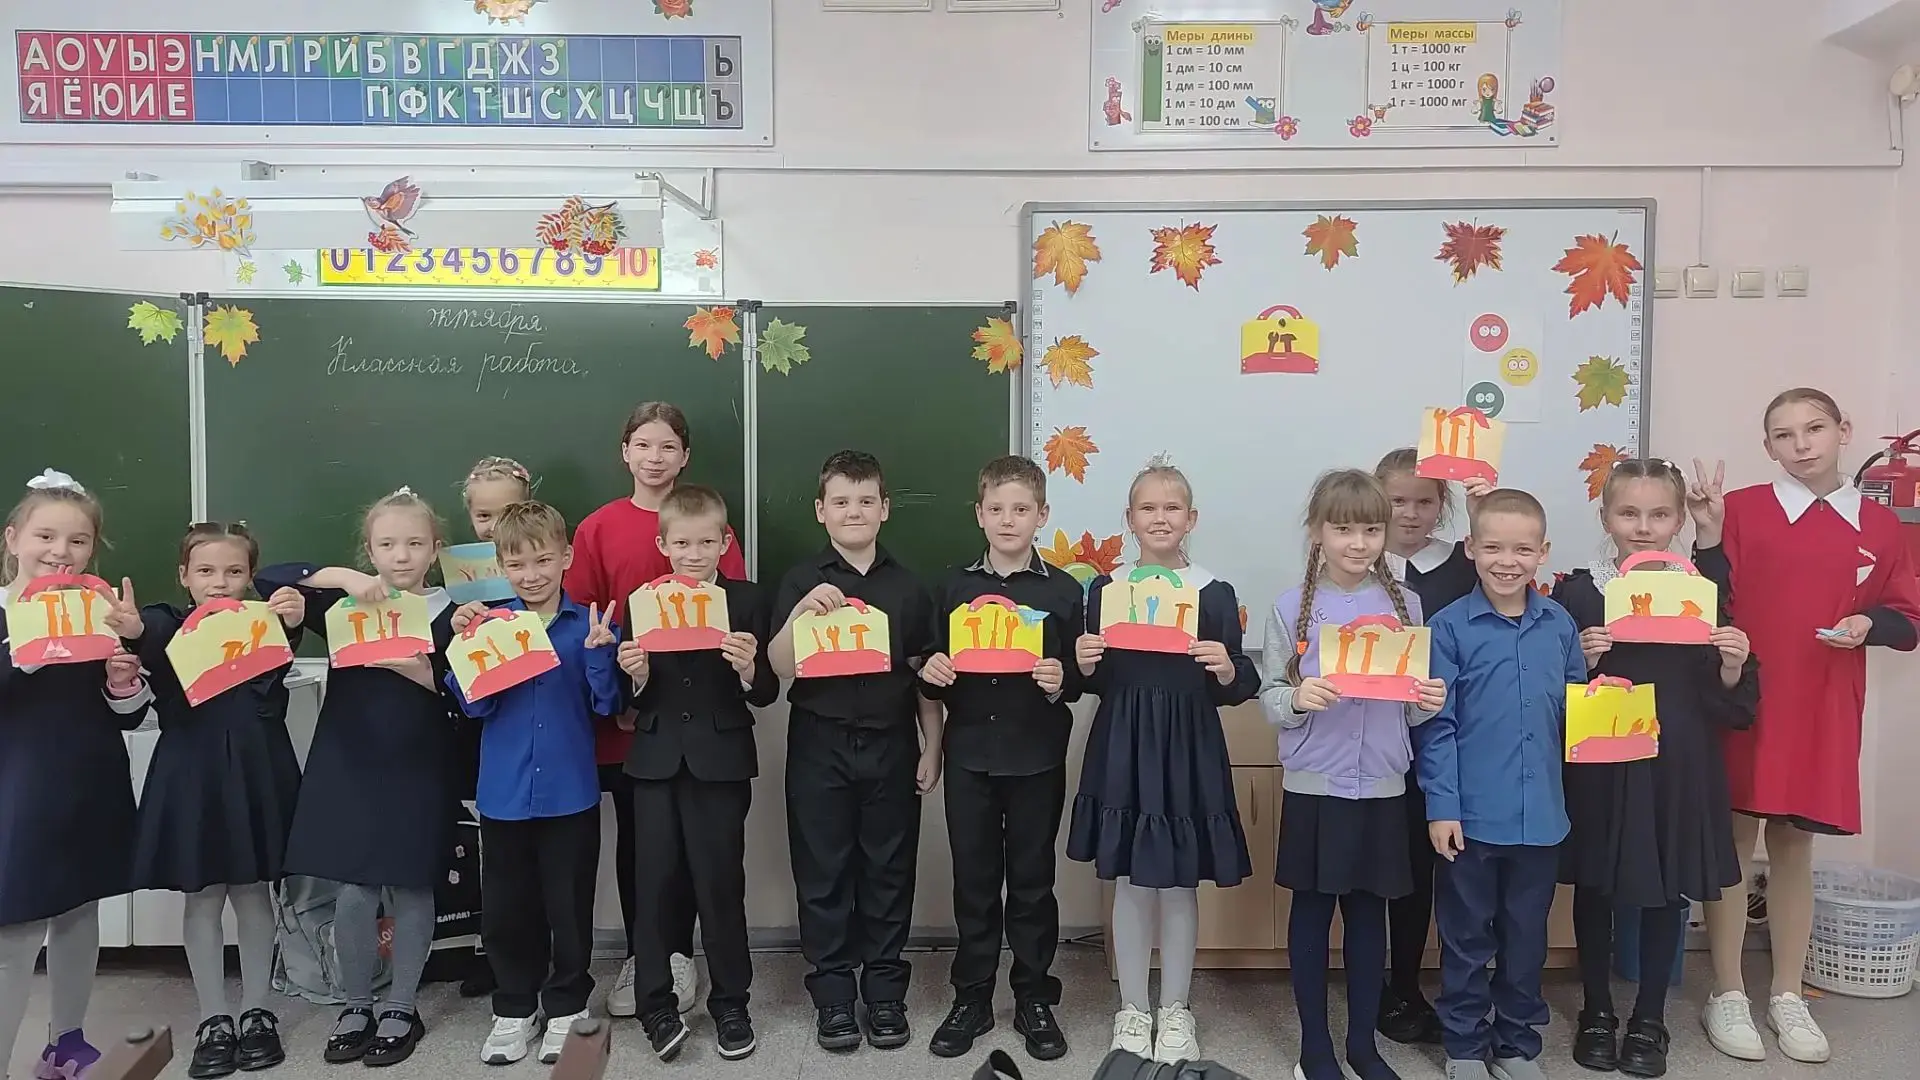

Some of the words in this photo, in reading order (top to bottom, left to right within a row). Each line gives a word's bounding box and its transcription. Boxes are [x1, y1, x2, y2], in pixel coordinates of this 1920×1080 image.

[1166, 31, 1204, 42] Меры
[1210, 32, 1253, 42] длины
[1390, 29, 1428, 40] Меры
[1435, 30, 1474, 39] массы
[1167, 46, 1172, 55] 1
[1177, 47, 1192, 55] см
[1207, 45, 1220, 55] 10
[1224, 47, 1244, 55] мм
[1392, 44, 1398, 54] 1
[1400, 46, 1408, 54] т
[1422, 44, 1450, 54] 1000
[1454, 45, 1466, 54] кг
[23, 38, 50, 70] А
[56, 38, 86, 72] О
[93, 38, 119, 72] У
[128, 38, 155, 72] Ы
[164, 38, 186, 72] Э
[197, 39, 220, 72] Н
[228, 39, 258, 72] М
[265, 40, 288, 72] Л
[304, 41, 322, 72] Р
[335, 37, 358, 73] Й
[367, 42, 386, 73] Б
[403, 42, 422, 74] В
[439, 42, 455, 74] Г
[467, 44, 494, 80] Д
[500, 43, 530, 75] Ж
[540, 43, 560, 75] З
[715, 45, 732, 77] Ь
[1166, 63, 1172, 73] 1
[1176, 65, 1194, 74] дм
[1209, 63, 1223, 73] 10
[1226, 65, 1242, 73] см
[1392, 62, 1398, 72] 1
[1402, 63, 1410, 73] ц
[1424, 61, 1445, 71] 100
[1449, 63, 1461, 71] кг
[1166, 81, 1171, 90] 1
[1176, 82, 1194, 92] дм
[1208, 81, 1230, 90] 100
[1391, 80, 1397, 89] 1
[1401, 81, 1413, 89] кг
[1427, 79, 1456, 89] 1000
[1459, 81, 1464, 89] г
[28, 83, 47, 114] Я
[64, 78, 82, 115] Ё
[94, 83, 123, 116] Ю
[129, 83, 154, 116] И
[168, 84, 187, 116] Е
[367, 86, 389, 117] П
[398, 86, 427, 118] Ф
[438, 87, 460, 119] К
[472, 88, 493, 119] Т
[503, 88, 532, 119] Ш
[540, 88, 561, 120] С
[575, 89, 597, 120] Х
[609, 90, 634, 124] Ц
[644, 90, 664, 120] Ч
[674, 89, 705, 124] Щ
[711, 90, 732, 121] Ъ
[1165, 99, 1171, 108] 1
[1175, 100, 1185, 108] м
[1199, 99, 1213, 108] 10
[1217, 100, 1236, 110] дм
[1391, 97, 1397, 107] 1
[1401, 99, 1406, 107] г
[1419, 97, 1448, 107] 1000
[1452, 98, 1467, 107] мг
[1165, 116, 1171, 126] 1
[1175, 118, 1185, 126] м
[1199, 116, 1220, 126] 100
[1224, 118, 1240, 126] см
[331, 248, 350, 271] 0
[360, 248, 374, 271] 1
[415, 248, 435, 273] 3
[442, 248, 463, 273] 4
[472, 248, 491, 273] 5
[499, 248, 518, 274] 6
[613, 248, 648, 276] 10
[327, 336, 464, 376] Классная
